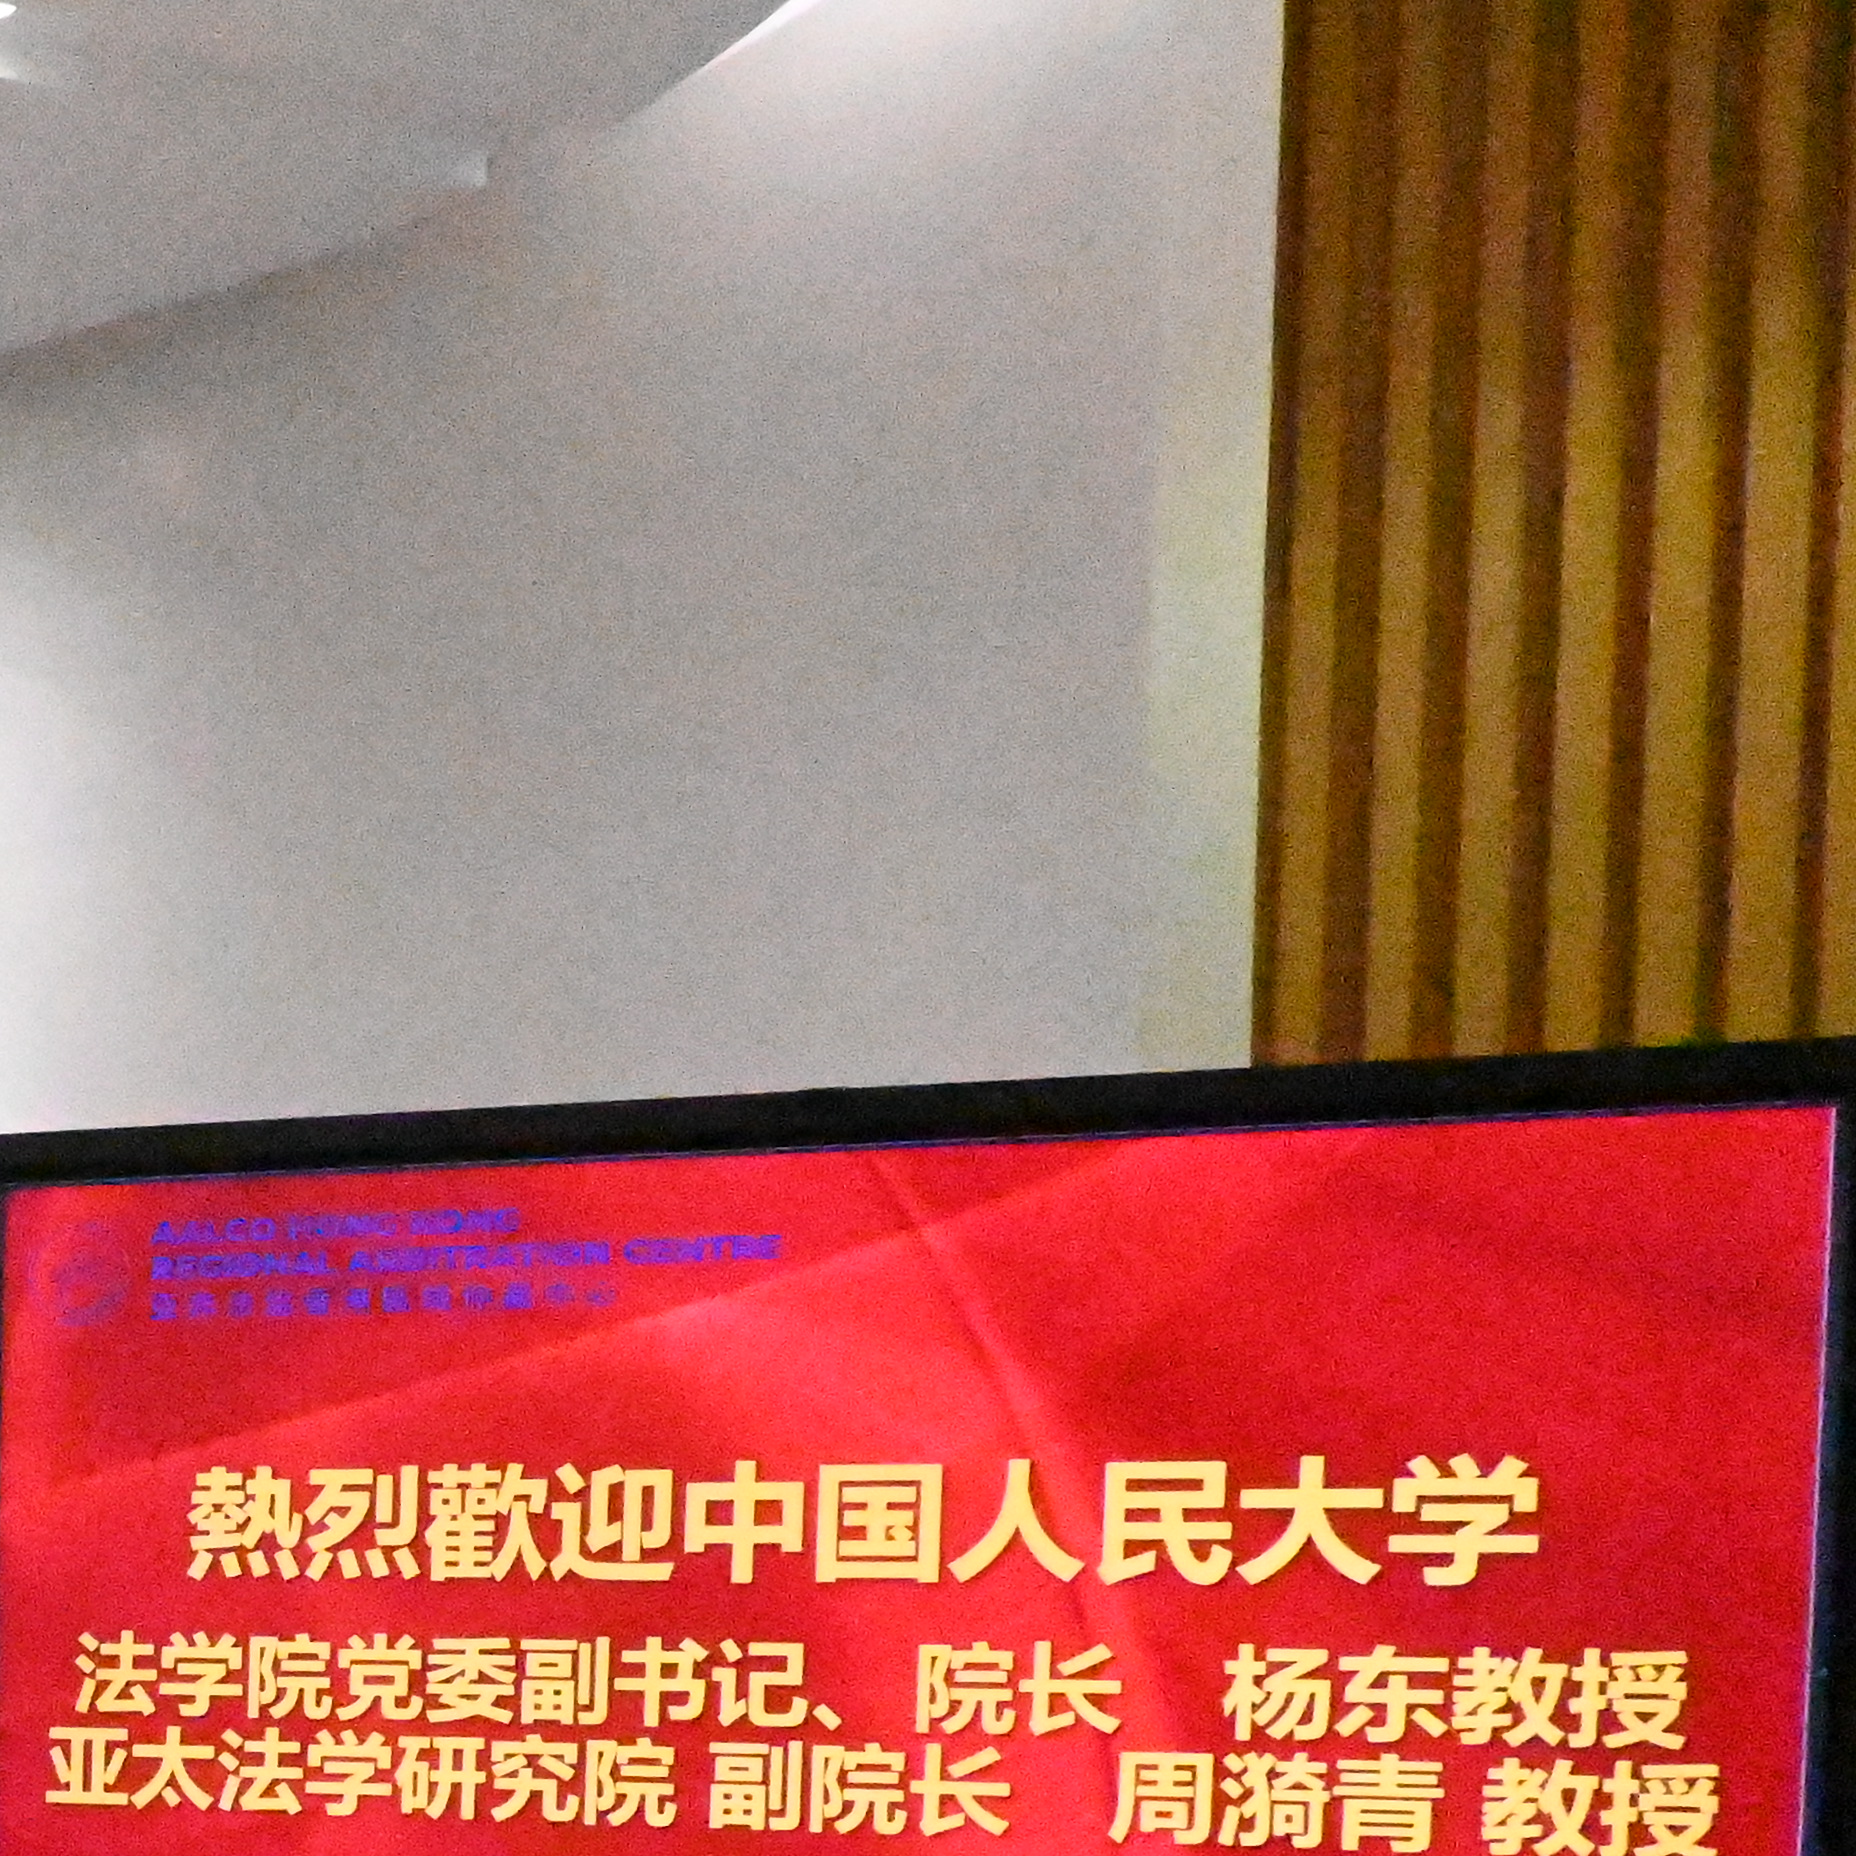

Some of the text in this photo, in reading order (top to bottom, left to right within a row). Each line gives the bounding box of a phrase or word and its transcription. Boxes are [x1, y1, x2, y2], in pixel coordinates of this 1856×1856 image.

[188, 1455, 1540, 1587] 熱烈歡迎中国人民大学
[1223, 1644, 1689, 1750] 杨东教授
[45, 1725, 677, 1828] 亚太法学研究院
[708, 1740, 1011, 1837] 副院长
